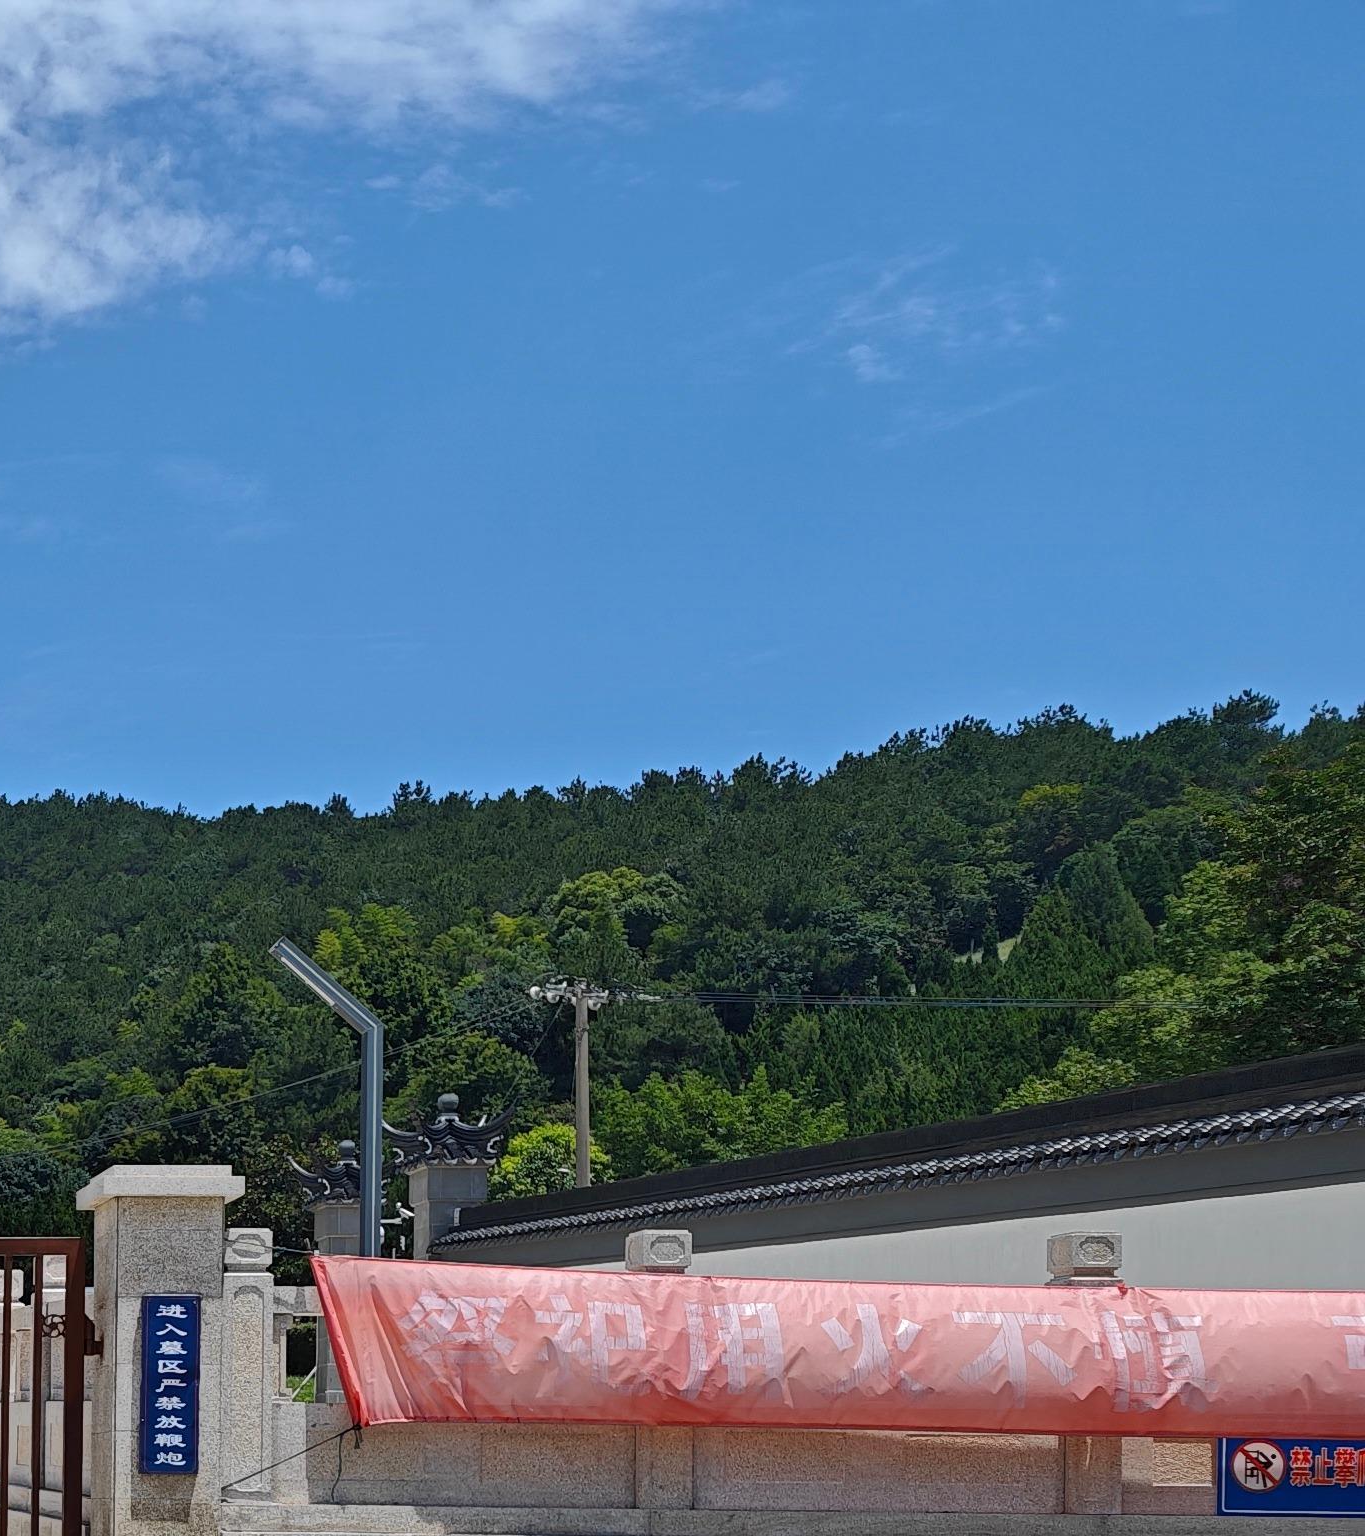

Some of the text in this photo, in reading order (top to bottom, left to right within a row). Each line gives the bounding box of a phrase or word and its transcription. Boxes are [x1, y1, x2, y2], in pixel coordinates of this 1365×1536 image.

[153, 1304, 188, 1466] 进入墓区严禁放鞭炮
